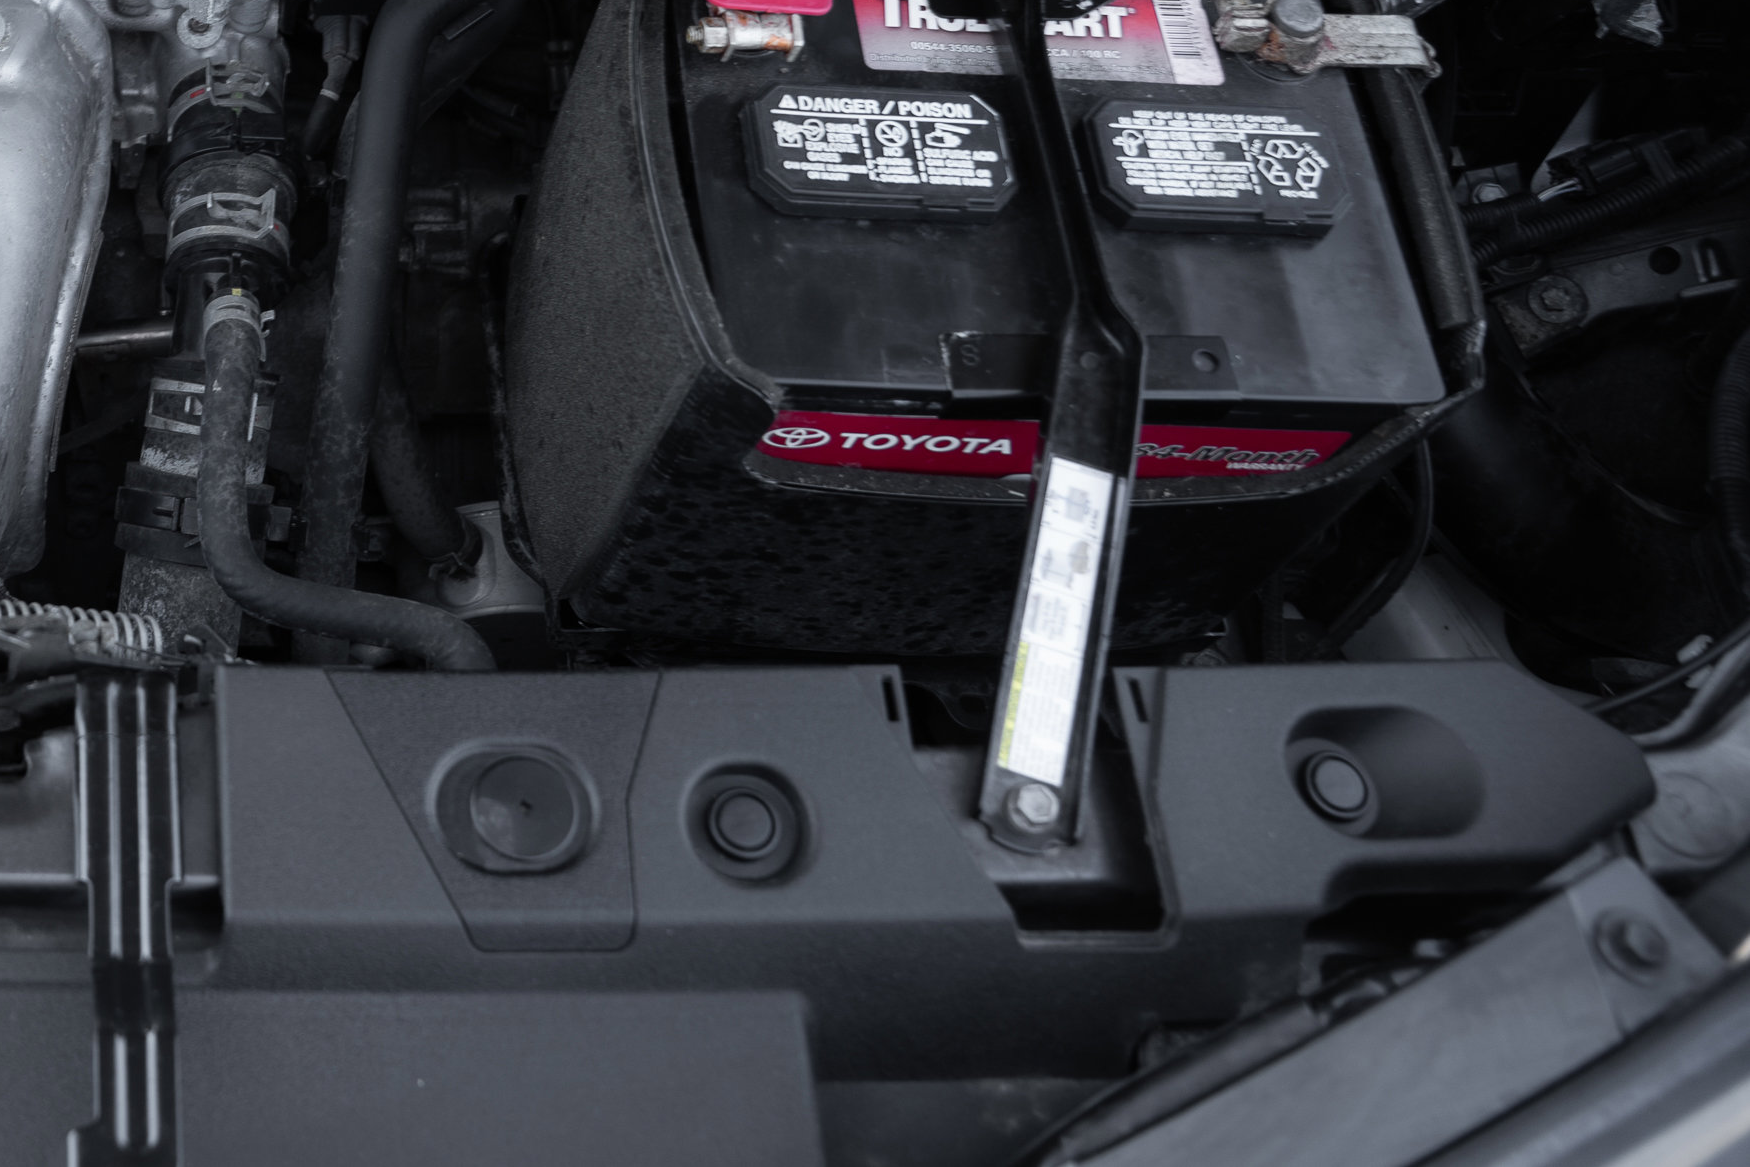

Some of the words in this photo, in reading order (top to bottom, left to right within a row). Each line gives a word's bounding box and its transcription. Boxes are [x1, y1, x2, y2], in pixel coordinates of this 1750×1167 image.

[797, 95, 880, 115] DANGER
[881, 100, 896, 115] /
[897, 100, 974, 119] POISON
[839, 431, 1013, 455] TOYOTA
[1225, 461, 1307, 471] WARRANTY
